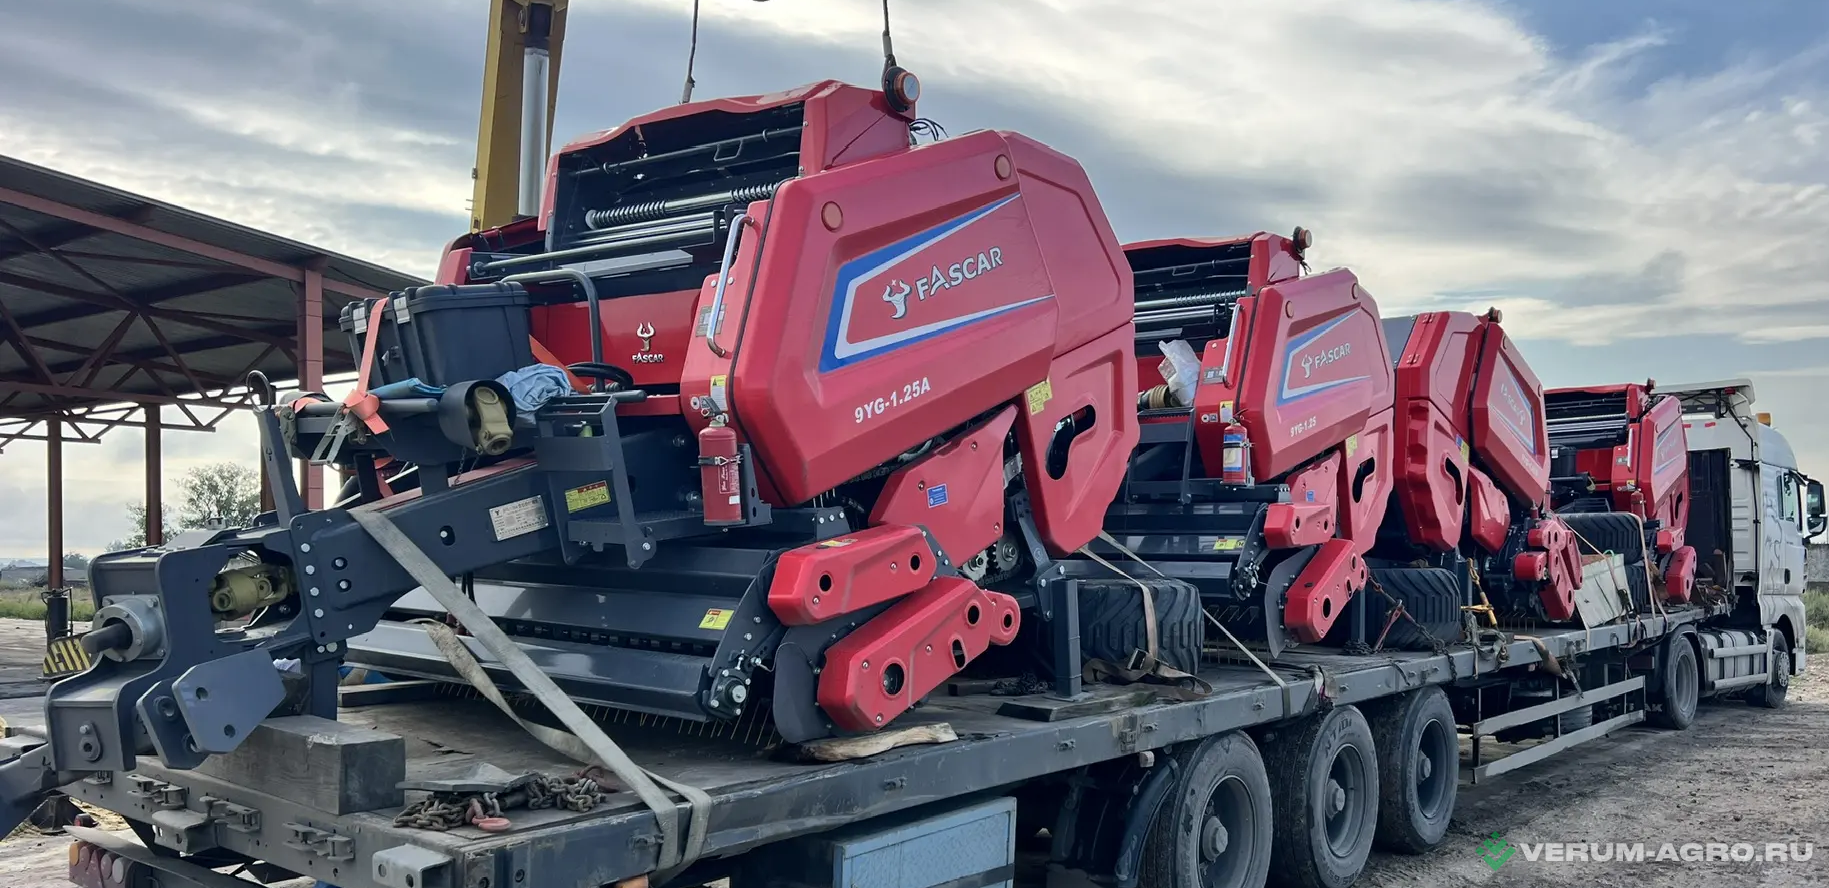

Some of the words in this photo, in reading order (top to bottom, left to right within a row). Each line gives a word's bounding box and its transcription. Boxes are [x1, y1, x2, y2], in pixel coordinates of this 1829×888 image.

[915, 247, 1003, 301] FASCAR
[631, 352, 664, 363] FASCAR
[1315, 343, 1351, 369] FASCAR
[854, 377, 931, 423] 9YG-1.25A
